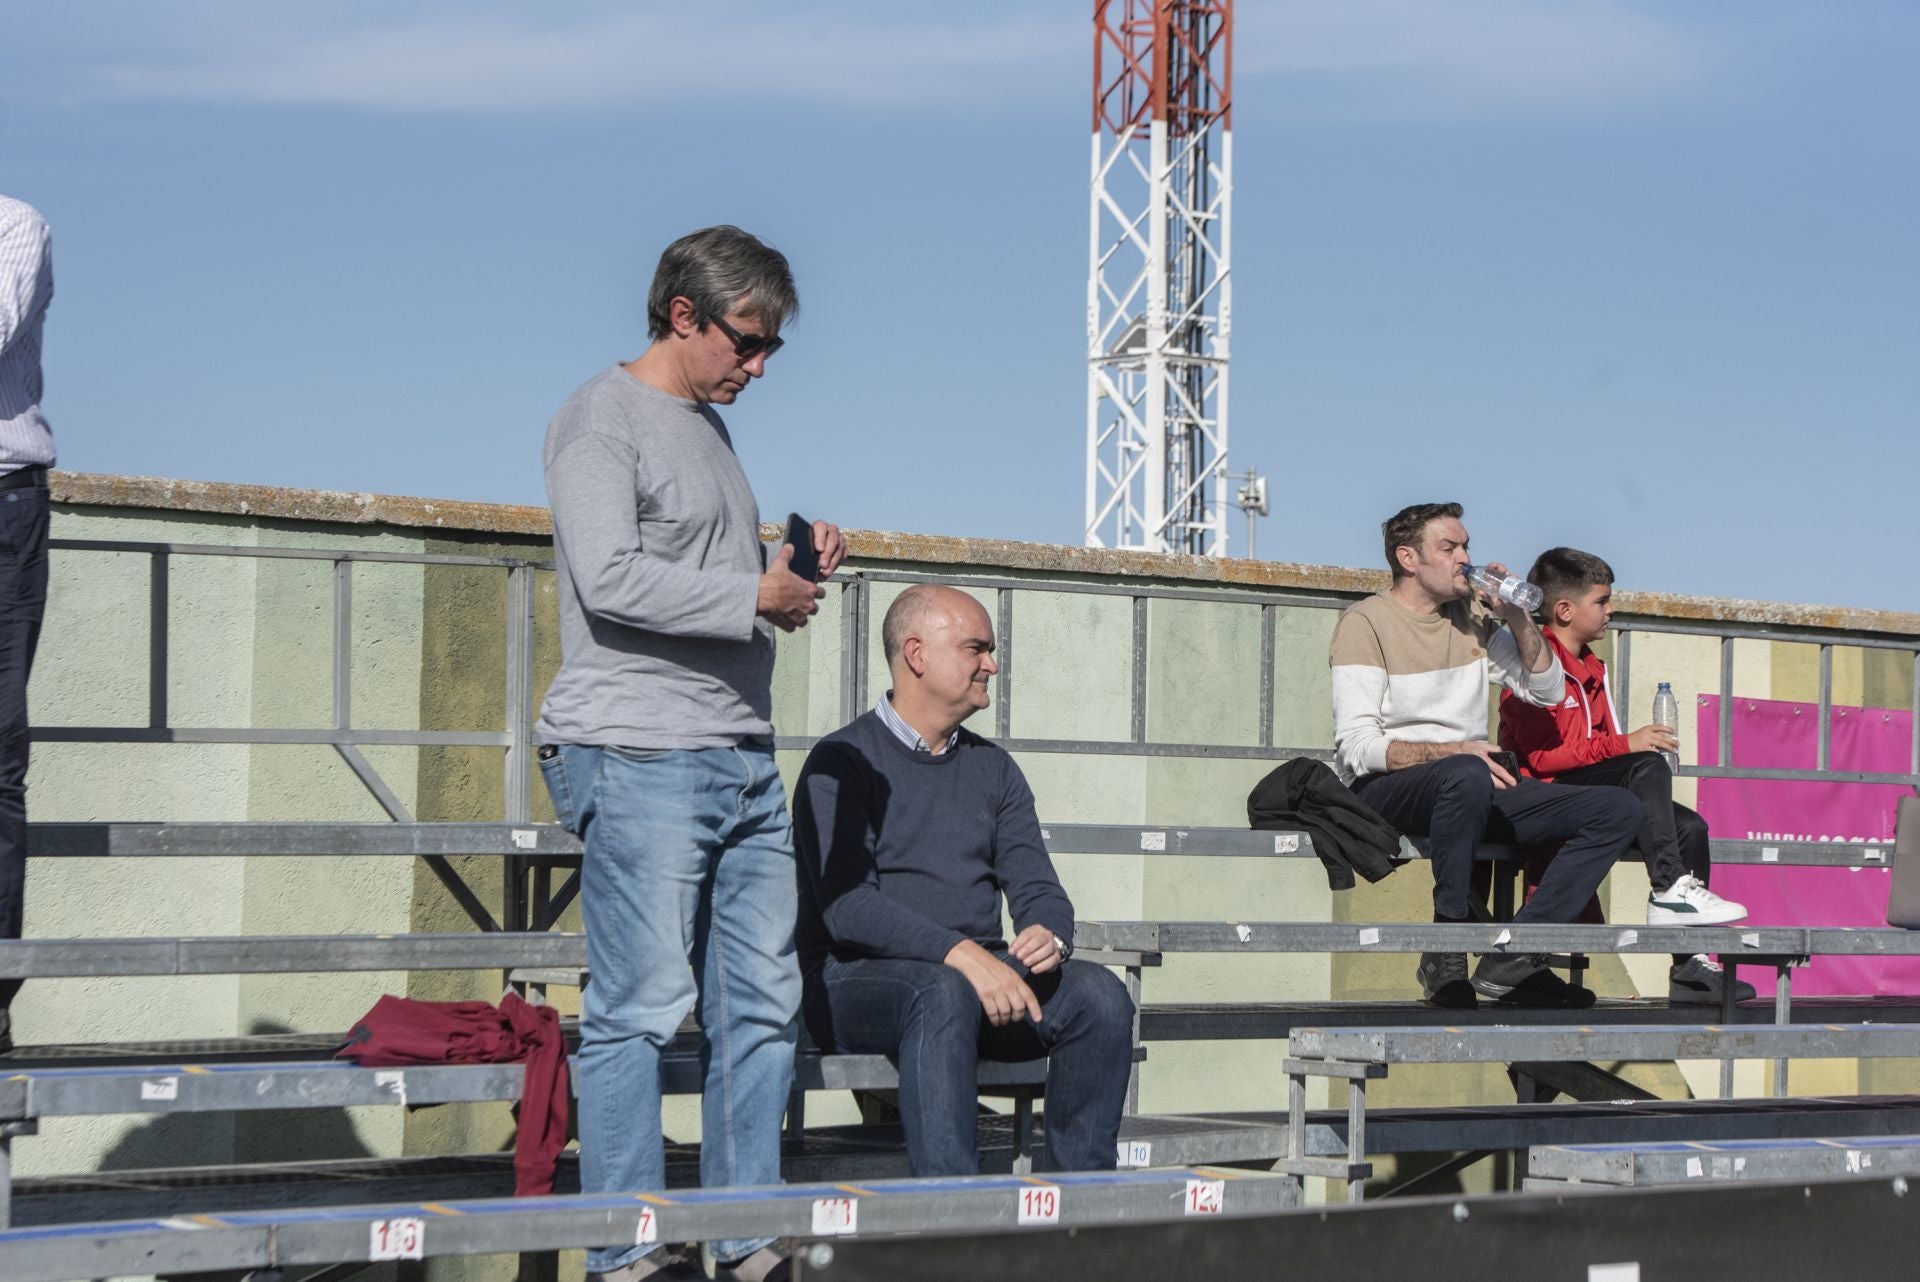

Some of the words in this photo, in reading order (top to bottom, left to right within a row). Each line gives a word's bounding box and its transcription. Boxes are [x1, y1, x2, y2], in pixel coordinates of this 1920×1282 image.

[1134, 1147, 1146, 1162] 10
[1025, 1190, 1055, 1217] 119
[640, 1213, 651, 1234] 7
